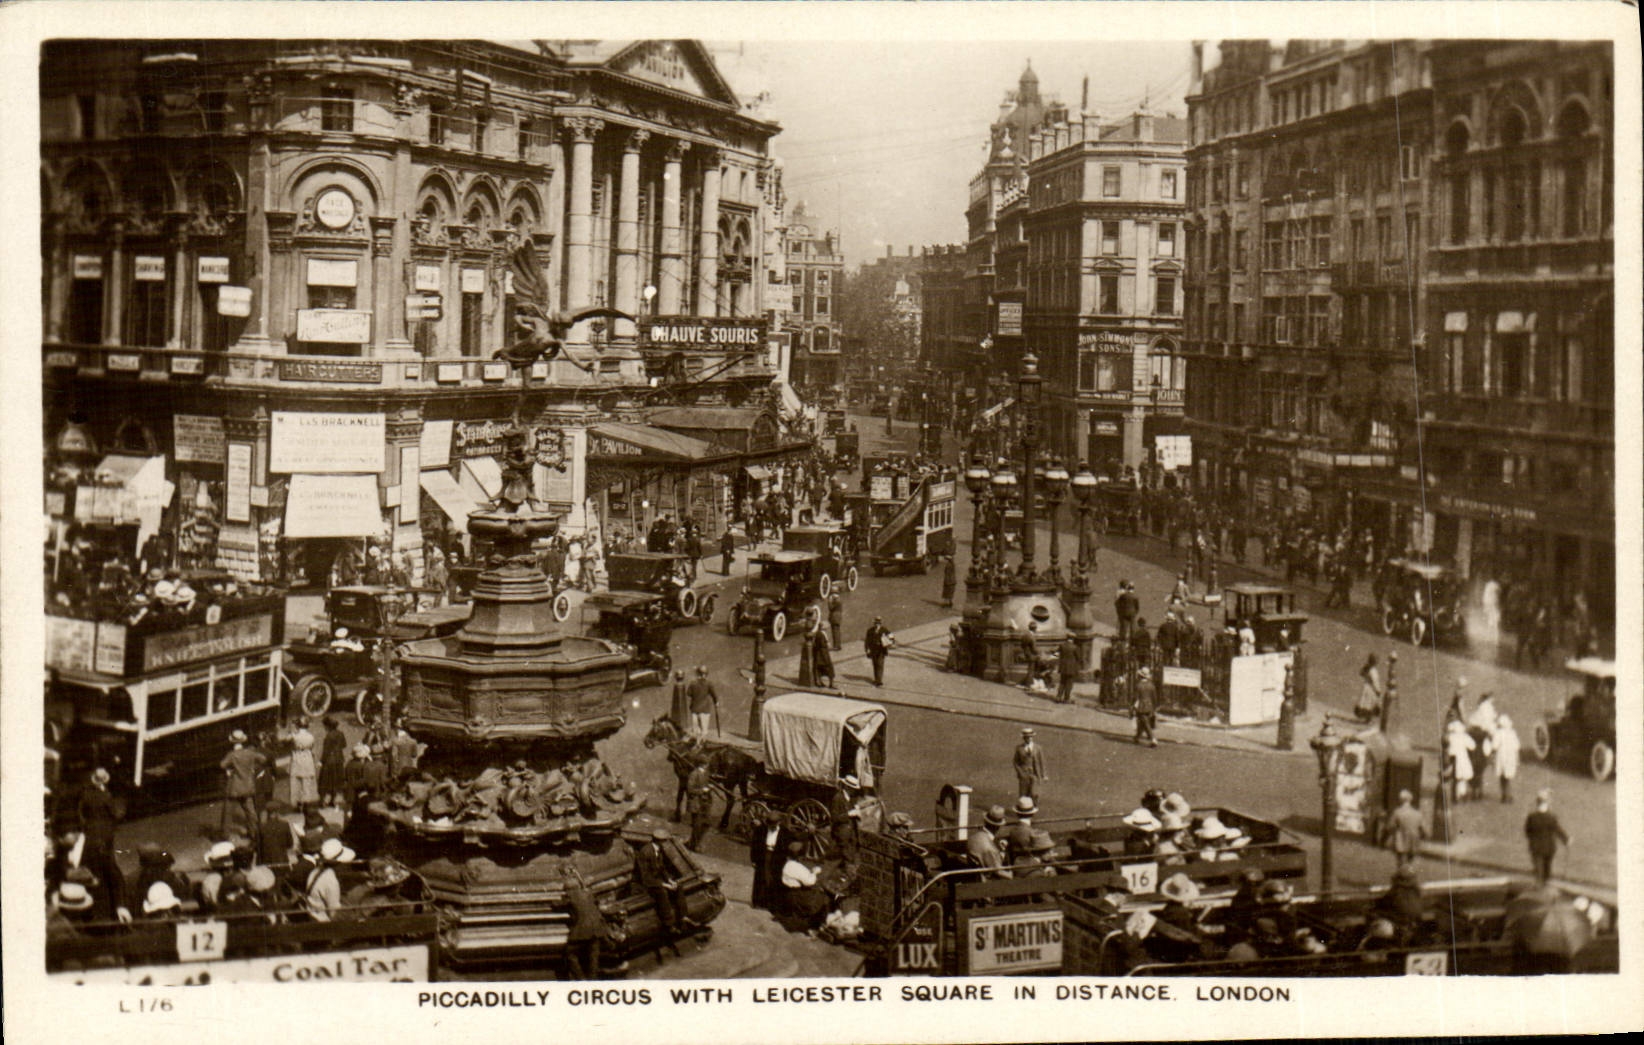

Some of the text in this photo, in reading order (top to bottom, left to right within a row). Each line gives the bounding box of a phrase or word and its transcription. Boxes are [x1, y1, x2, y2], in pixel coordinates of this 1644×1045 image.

[651, 326, 758, 344] CHAUVE SOURIS
[1098, 343, 1120, 353] SONS
[321, 417, 381, 427] BRACKNELL
[601, 438, 642, 456] PAVILION
[1132, 871, 1150, 888] 16
[191, 932, 214, 952] 12
[898, 944, 939, 968] LUX
[994, 949, 1042, 965] THEATRE
[272, 956, 407, 982] Coal Tar
